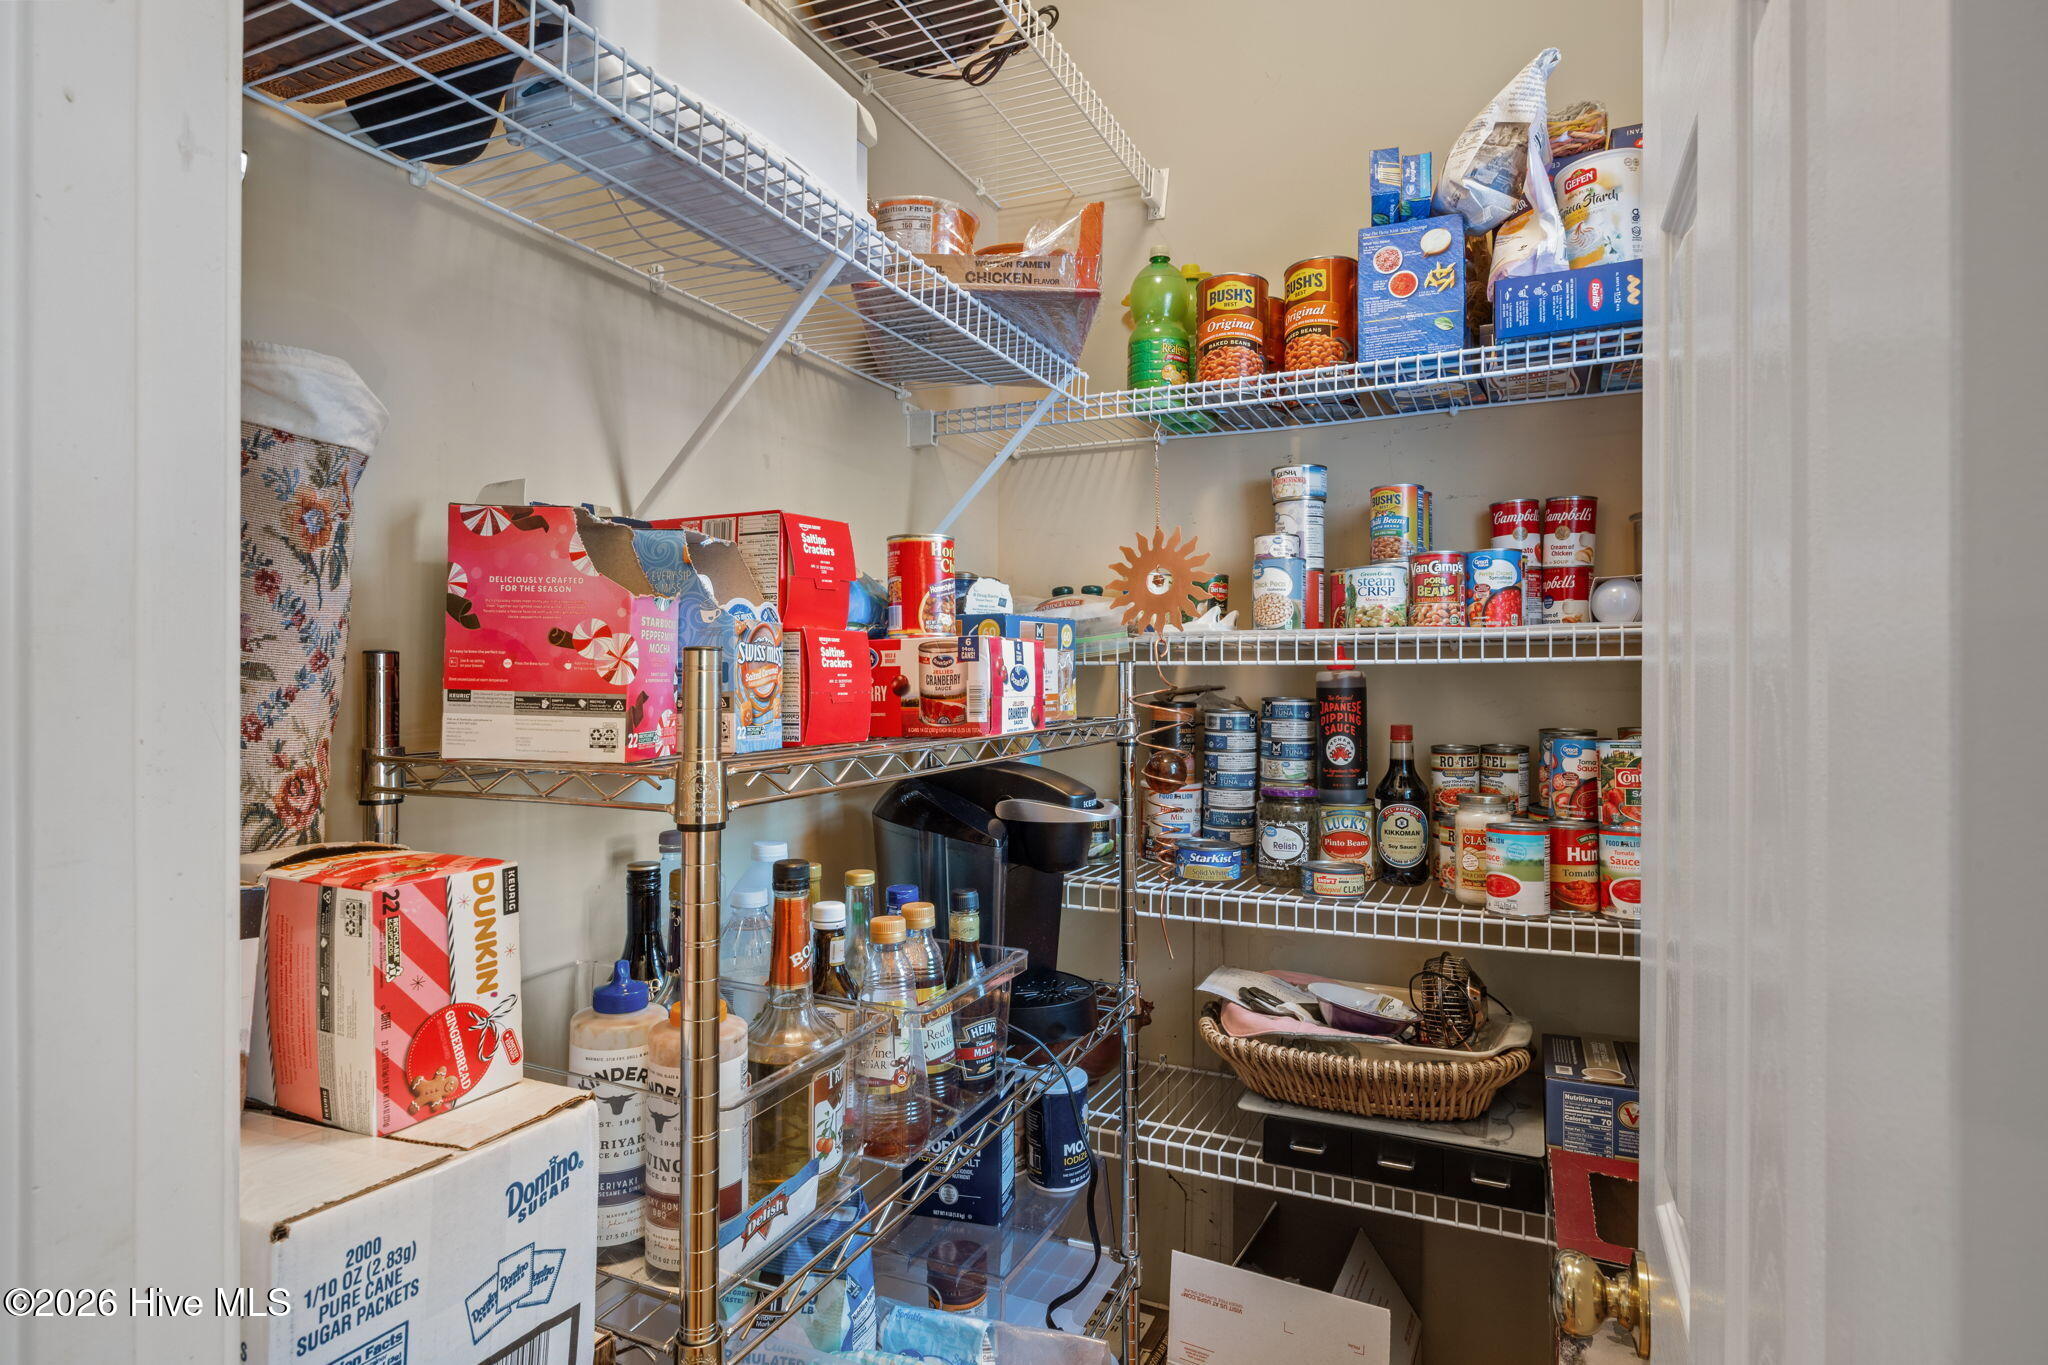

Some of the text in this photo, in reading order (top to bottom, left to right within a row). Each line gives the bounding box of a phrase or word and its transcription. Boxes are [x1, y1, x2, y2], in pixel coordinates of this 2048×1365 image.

[1565, 171, 1594, 190] GEFEN
[1583, 190, 1618, 207] Starch
[909, 204, 932, 213] Facts
[1016, 260, 1051, 269] RAMEN
[965, 270, 1032, 284] CHICKEN
[1209, 287, 1254, 306] BUSH'S
[1590, 282, 1600, 309] Barilla
[1207, 318, 1255, 332] Original
[1208, 339, 1251, 350] BAKED BEANS
[1372, 494, 1401, 507] BUSH'S
[1494, 509, 1540, 524] Campbell
[1545, 507, 1592, 523] Campbell's
[801, 533, 827, 545] Saltine
[803, 543, 835, 556] Crackers
[1411, 559, 1464, 575] Van Camp's
[489, 576, 584, 584] DELICIOUSLY CRAFTED
[652, 570, 691, 582] EVERY SIP
[1358, 577, 1395, 586] steam
[1424, 576, 1446, 585] PORK
[1358, 587, 1395, 596] CRISP
[1417, 585, 1455, 596] BEANS
[649, 643, 671, 654] MOCHA
[820, 646, 845, 657] Saltine
[822, 657, 852, 668] Crackers
[926, 674, 961, 686] CRANBERRY
[1008, 707, 1028, 719] CRANBERRY
[1320, 701, 1362, 715] JAPANESE
[1320, 712, 1362, 726] DIPPING
[737, 726, 746, 739] 22
[1324, 724, 1356, 736] SAUCE
[628, 733, 638, 748] 22
[1577, 764, 1598, 772] Sauc
[1383, 806, 1421, 818] ALL-PURPOSE
[1324, 816, 1369, 831] LUCK'S
[1273, 841, 1298, 850] Relish
[1324, 838, 1345, 846] Pinto
[1464, 836, 1486, 845] CLAS
[1606, 839, 1618, 847] FOOD
[1189, 852, 1232, 863] StarKist
[1567, 847, 1598, 861] Hun
[1610, 856, 1640, 866] Sauce
[1562, 869, 1595, 877] Tomato
[508, 870, 516, 912] KEURIG
[1343, 885, 1364, 893] CLAMS
[382, 889, 400, 915] 22
[473, 872, 499, 998] DUNKIN'
[381, 1012, 391, 1031] COFFEE
[927, 1029, 945, 1041] Red
[970, 1022, 996, 1038] HEINZ
[444, 1010, 471, 1090] GINGERBREAD
[974, 1046, 994, 1058] MALT
[1564, 1094, 1612, 1106] Nutrition Facts
[620, 1117, 642, 1126] 1946
[1564, 1114, 1612, 1126] Calories 70
[1064, 1152, 1088, 1166] IODIZE
[505, 1150, 580, 1218] Domino
[600, 1177, 638, 1191] ERIYAKI
[518, 1176, 569, 1224] SUGAR
[747, 1198, 785, 1234] Delish
[345, 1237, 382, 1268] 2000
[304, 1240, 417, 1309] 1/10 OZ (2.83g)
[500, 1261, 528, 1288] Domino
[319, 1267, 403, 1324] PURE CANE
[896, 1308, 924, 1321] Sprinkle
[1229, 1306, 1243, 1315] VISIT
[297, 1279, 419, 1357] SUGAR PACKETS
[366, 1330, 403, 1357] Facts
